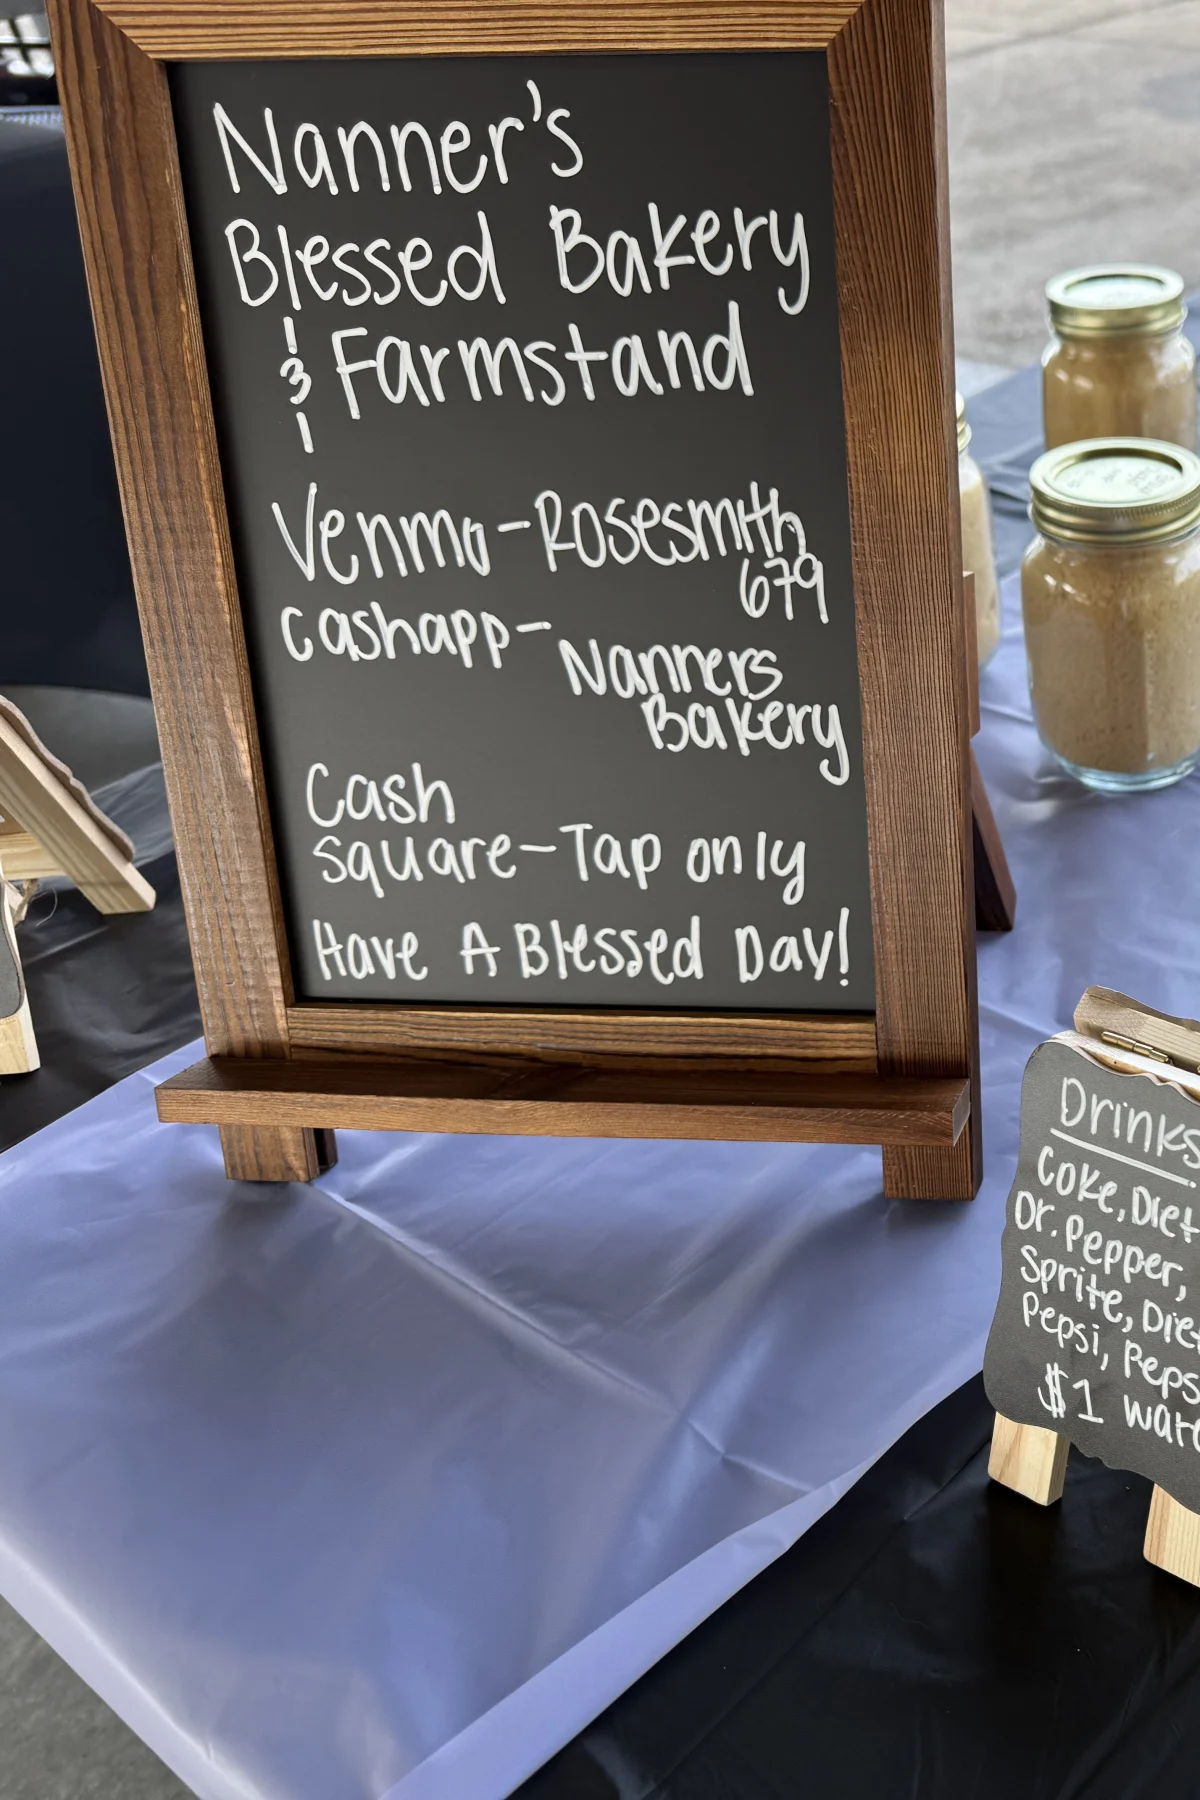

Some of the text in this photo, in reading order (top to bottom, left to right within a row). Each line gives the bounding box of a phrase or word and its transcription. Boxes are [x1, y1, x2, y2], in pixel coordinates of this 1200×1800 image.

[213, 80, 583, 195] Nanner's
[225, 203, 809, 315] Blessed Bakery
[331, 300, 754, 419] Farmstand
[740, 555, 829, 623] 679
[559, 639, 783, 699] Nanners
[640, 693, 849, 785] Bakery
[306, 762, 455, 827] Cash
[687, 832, 805, 905] only
[313, 907, 849, 986] Have A Blessed Day!
[1015, 1190, 1058, 1237] Dr.
[1021, 1244, 1133, 1333] Sprite,
[1038, 1362, 1104, 1423] $1
